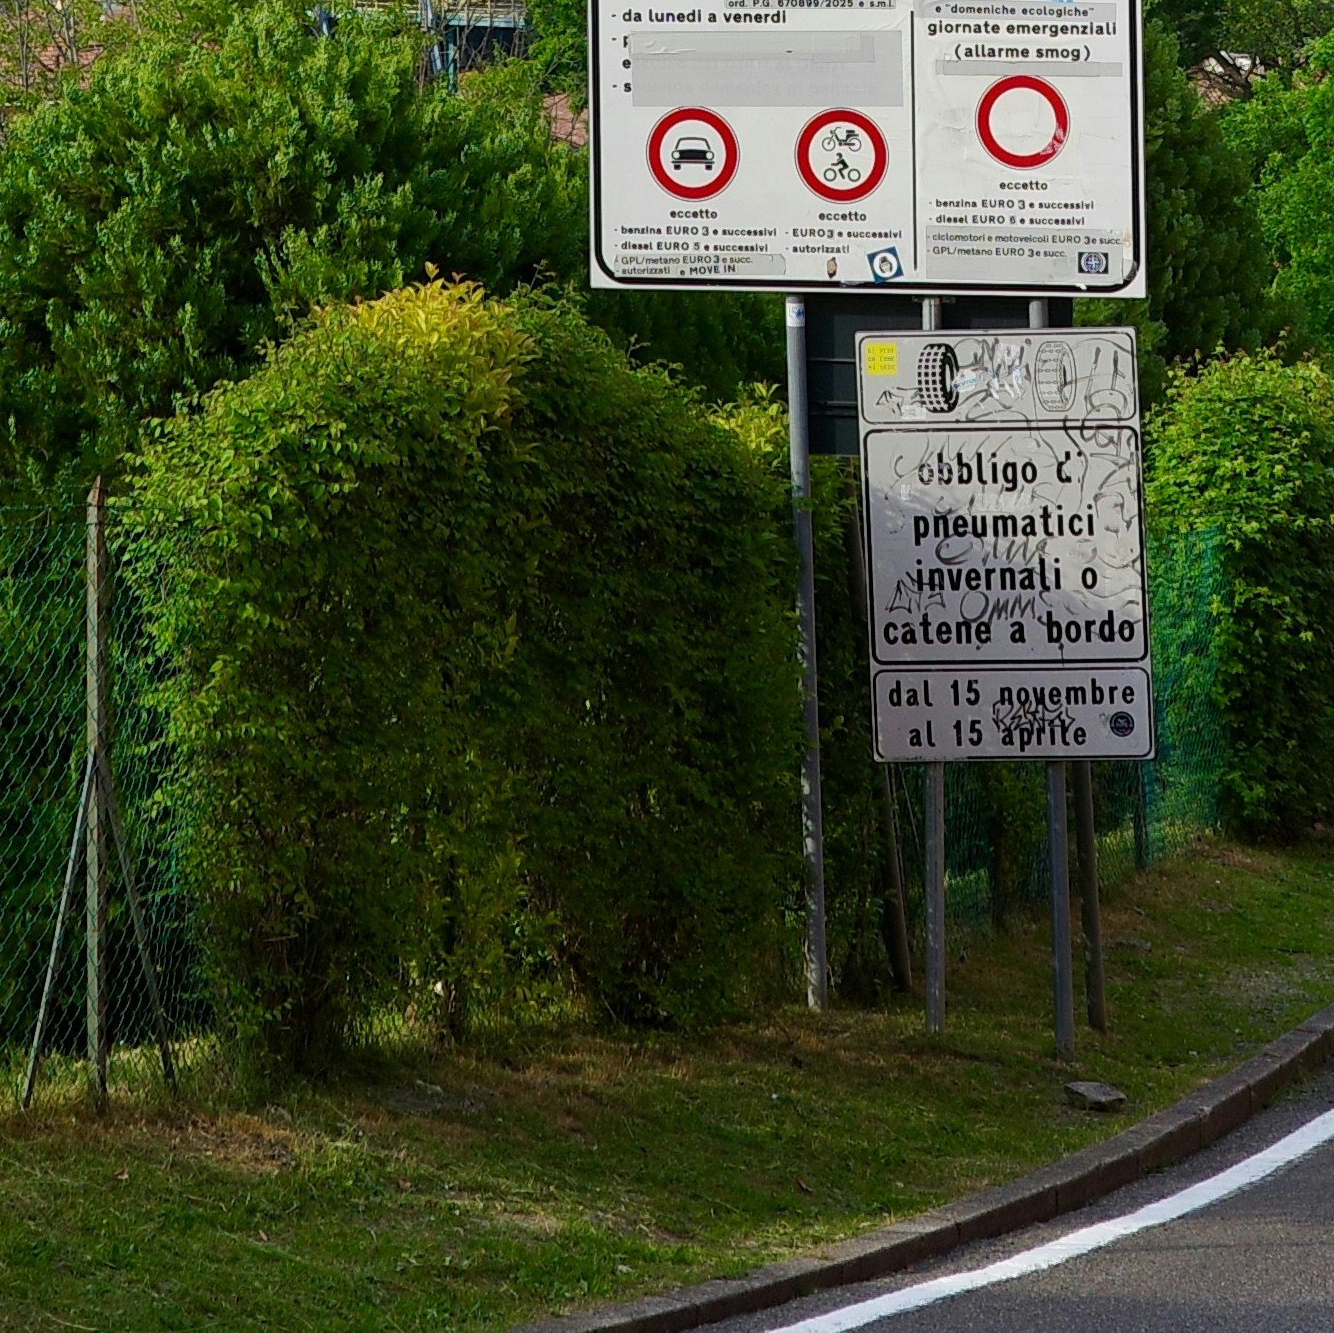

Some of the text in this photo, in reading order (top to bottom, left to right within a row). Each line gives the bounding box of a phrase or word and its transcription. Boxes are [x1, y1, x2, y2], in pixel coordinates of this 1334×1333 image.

[935, 5, 942, 13] e
[622, 9, 642, 23] da
[707, 12, 717, 23] a
[927, 20, 1117, 37] giornate emergenziali
[999, 180, 1048, 191] eccetto
[935, 199, 1095, 210] benzina EURO 3 e successivi
[669, 209, 718, 220] eccetto
[818, 211, 867, 222] eccetto
[935, 215, 969, 225] diesel
[972, 215, 1005, 225] EURO
[1019, 217, 1026, 225] e
[1028, 216, 1085, 226] successivi
[621, 225, 663, 235] benzina
[666, 226, 699, 236] EURO
[701, 226, 709, 236] 3
[721, 227, 777, 237] successivi
[837, 230, 844, 238] e
[846, 229, 902, 239] successivi
[932, 232, 985, 242] ciclomotori
[1051, 234, 1081, 244] EURO
[620, 241, 653, 250] diesel
[656, 241, 689, 251] EURO
[703, 244, 710, 252] e
[713, 243, 768, 253] successivi
[792, 244, 850, 254] autorizzati
[995, 247, 1025, 257] EURO
[682, 255, 712, 265] EURO
[621, 264, 736, 276] autorizzati e MOVE IN
[918, 452, 1038, 492] obbligo
[913, 503, 1095, 547] pneumatici
[915, 557, 1098, 591] invernali o
[883, 609, 1135, 645] catene a bordo
[888, 678, 1136, 707] dal 15 novembre
[909, 720, 1087, 752] al 15 aprile
